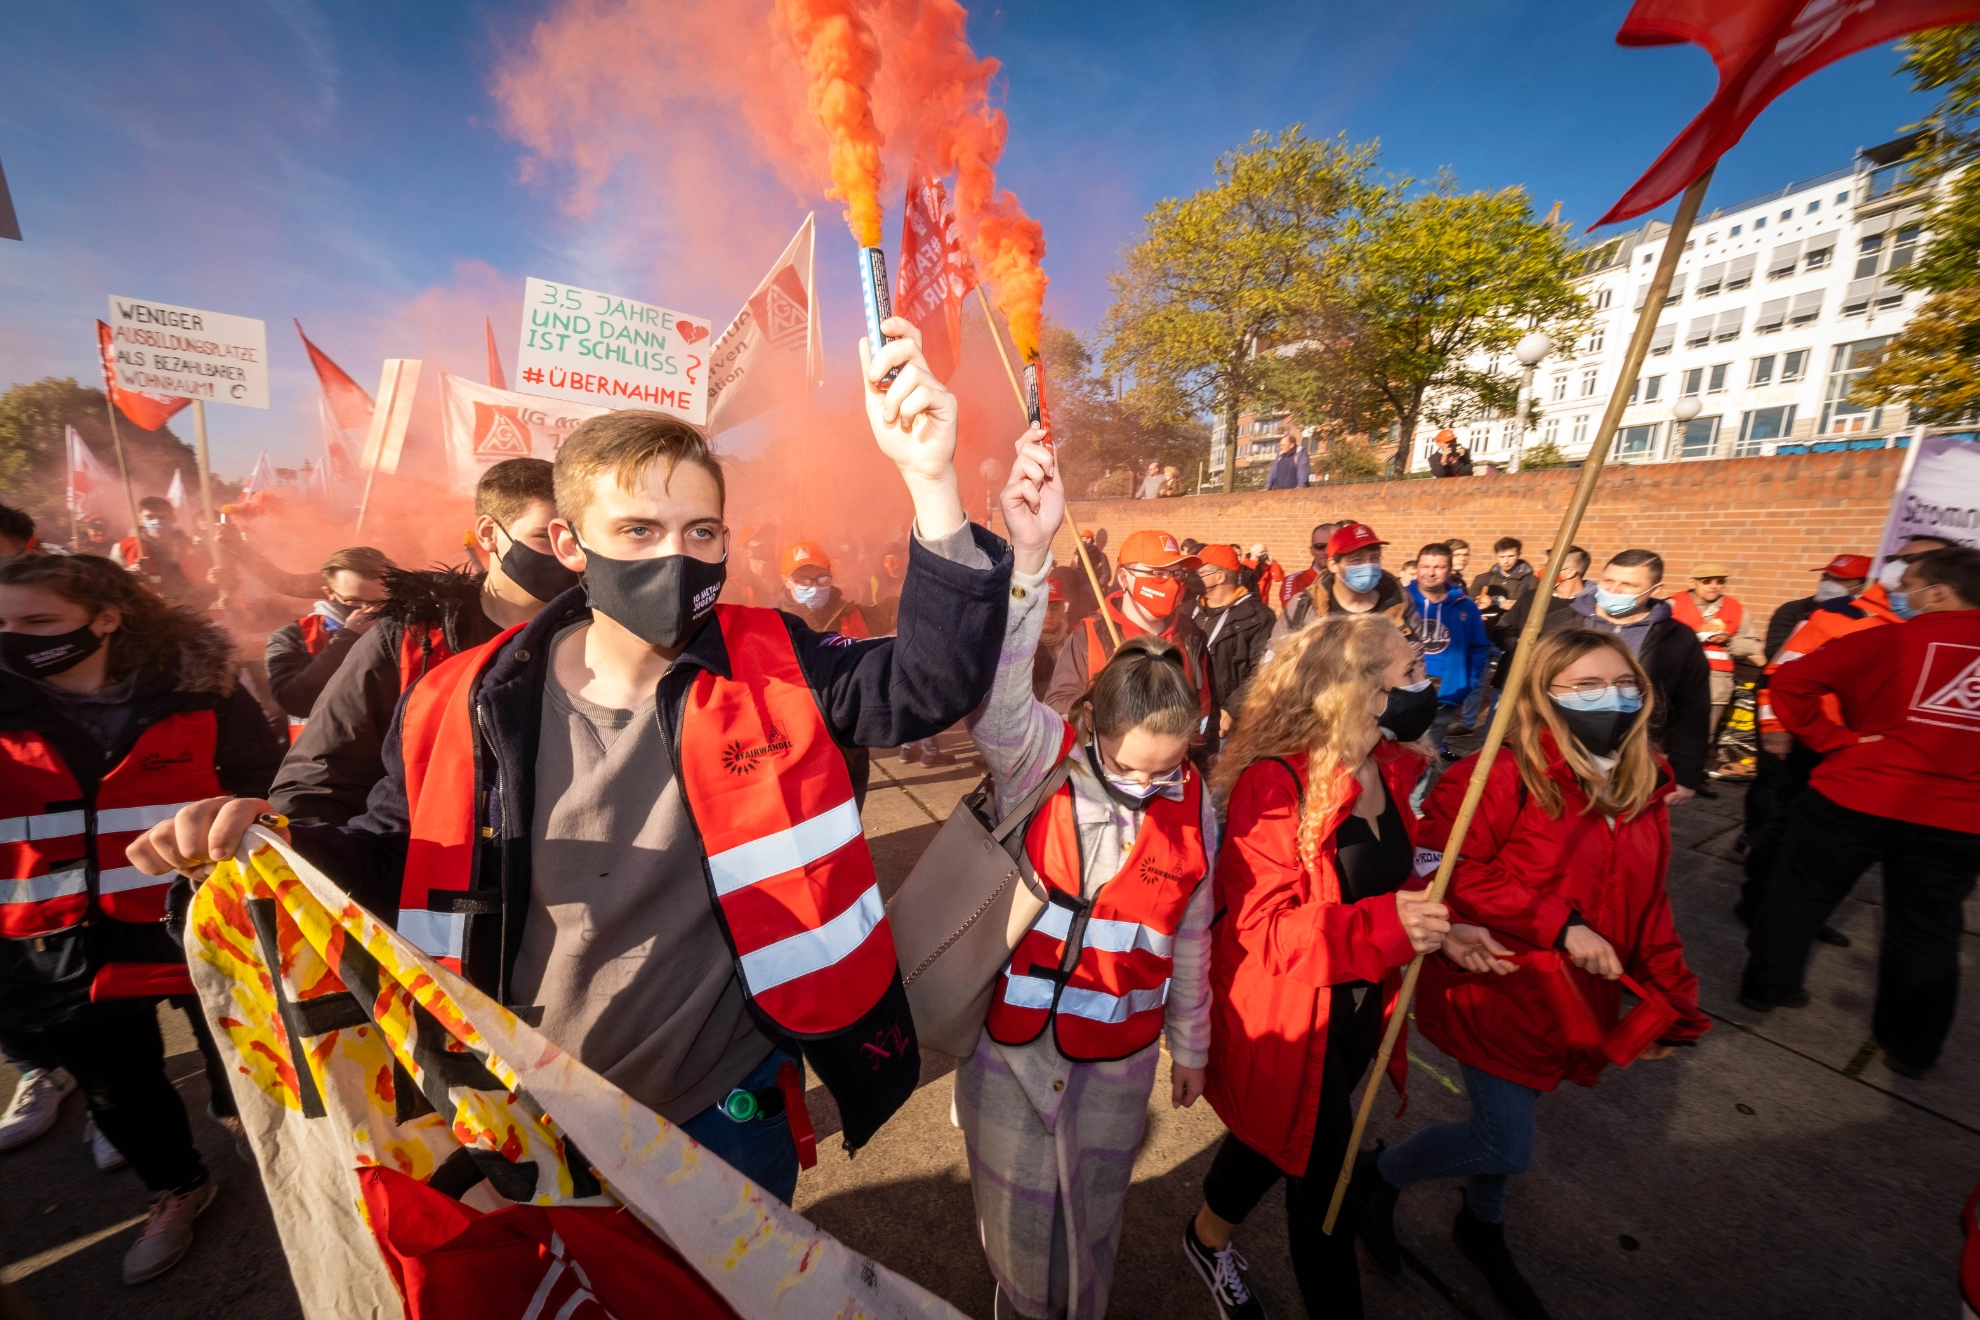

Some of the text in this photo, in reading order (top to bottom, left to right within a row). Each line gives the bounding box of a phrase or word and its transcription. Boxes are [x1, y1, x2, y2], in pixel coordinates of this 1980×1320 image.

[116, 301, 204, 332] WENIGER
[540, 284, 675, 332] 3,5 JAHRE
[114, 325, 259, 363] AUSBILDUNGSPLÄTZE
[531, 308, 667, 351] UND DANN
[116, 350, 247, 382] ALS BEZAHLBARER
[526, 328, 572, 352] IST
[577, 337, 679, 376] SCHLUSS
[120, 368, 215, 397] WOHNRAUM!
[522, 365, 693, 411] #ÜBERNAHME
[735, 740, 794, 762] #FAIRWANDEL
